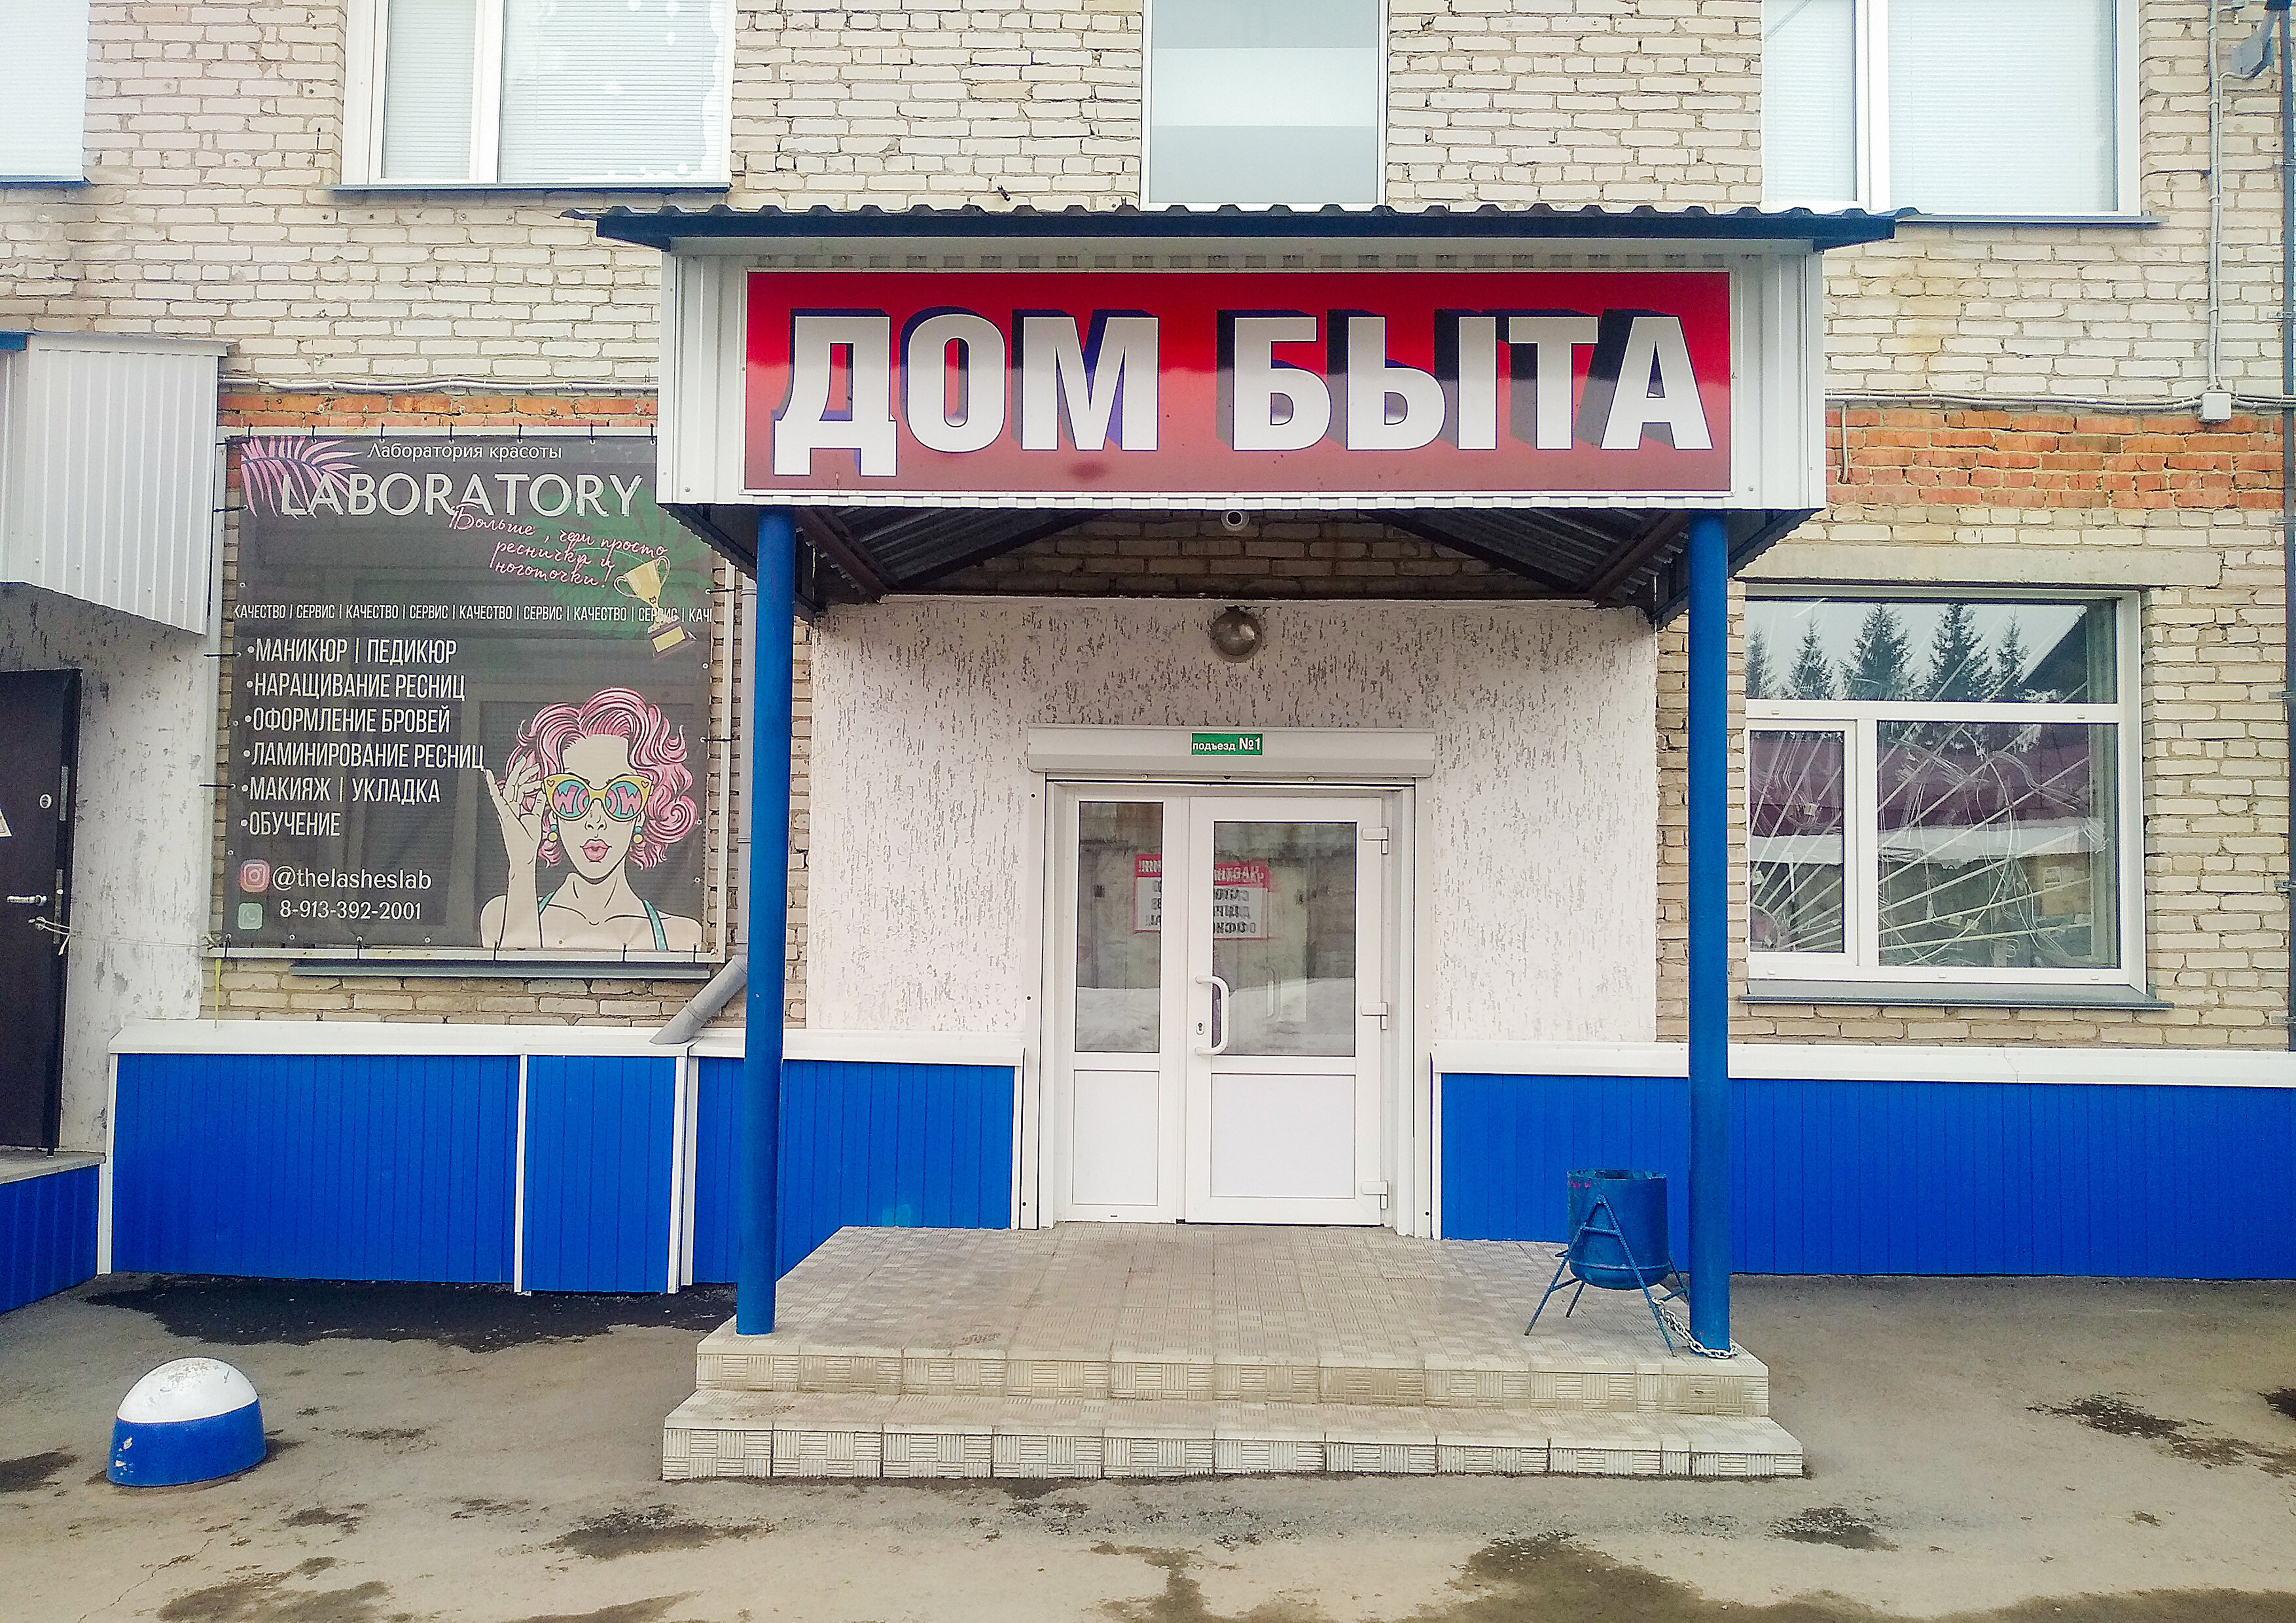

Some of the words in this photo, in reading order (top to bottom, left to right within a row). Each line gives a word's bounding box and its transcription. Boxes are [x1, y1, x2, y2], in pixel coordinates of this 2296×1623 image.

[774, 314, 1159, 477] ДОМ
[1232, 314, 1713, 452] БЫТА
[367, 442, 483, 462] Лаборатория
[490, 446, 563, 463] красоты
[281, 472, 643, 518] LABORATORY
[560, 529, 594, 546] чем
[600, 538, 669, 563] просто
[296, 604, 336, 620] СЕРВИС
[346, 604, 399, 620] КАЧЕСТВО
[409, 605, 449, 620] СЕРВИС
[459, 605, 513, 621] КАЧЕСТВО
[523, 605, 563, 621] СЕРВИС
[573, 606, 627, 622] КАЧЕСТВО
[255, 637, 348, 662] МАНИКЮР
[367, 638, 457, 666] ПЕДИКЮР
[254, 672, 391, 700] НАРАЩИВАНИЕ
[395, 673, 465, 702] РЕСНИЦ
[253, 707, 377, 732] ОФОРМЛЕНИЕ
[382, 705, 451, 734] БРОВЕЙ
[251, 741, 409, 768] ЛАМИНИРОВАНИЕ
[414, 743, 485, 772] РЕСНИЦ
[1193, 742, 1236, 752] подъезд
[1239, 737, 1261, 751] №1
[249, 776, 332, 801] МАКИЯЖ
[351, 777, 441, 805] УКЛАДКА
[249, 811, 342, 836] ОБУЧЕНИЕ
[272, 865, 432, 891] @thelasheslab
[279, 899, 422, 920] 8-913-392-2001
